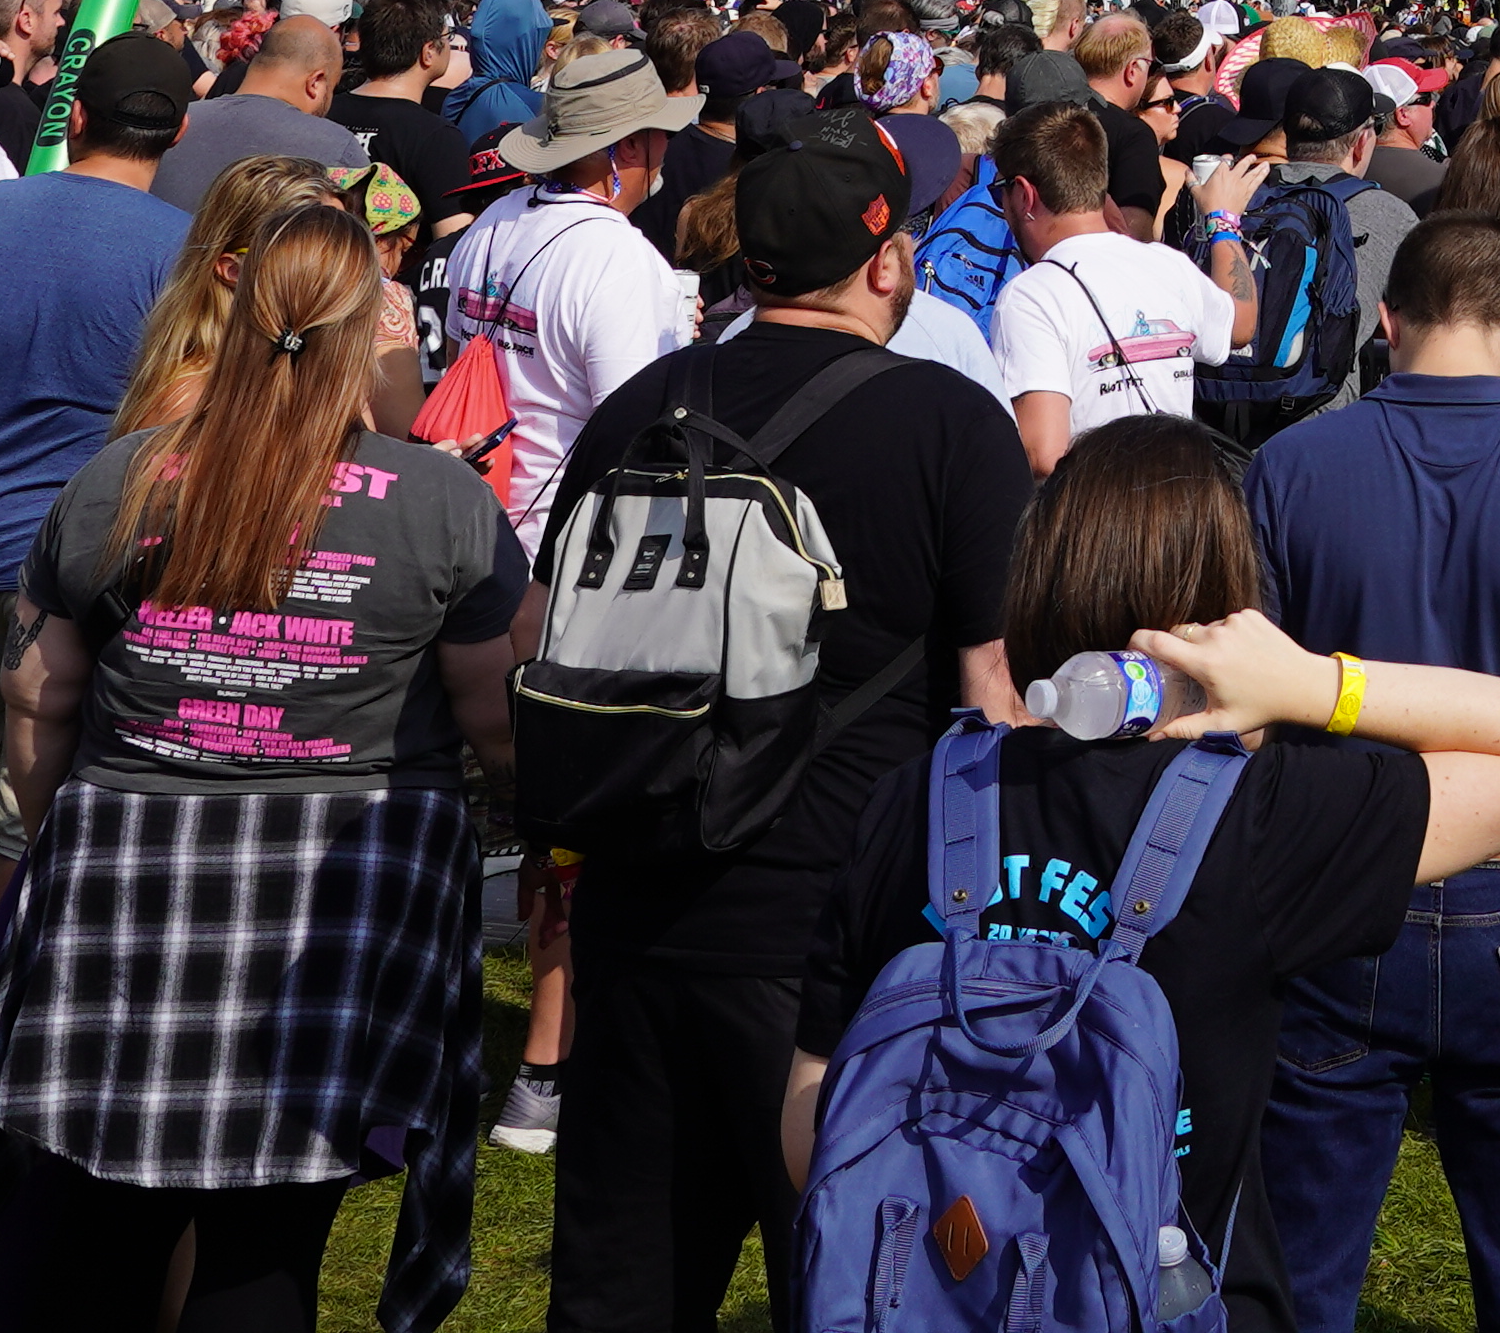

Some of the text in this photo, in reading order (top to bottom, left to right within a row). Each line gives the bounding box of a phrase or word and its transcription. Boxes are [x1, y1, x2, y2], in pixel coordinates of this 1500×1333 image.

[40, 36, 92, 138] CRAYON
[137, 601, 355, 646] WEEZER JACK WHITE
[177, 697, 286, 730] GREEN DAY
[1038, 857, 1116, 939] FES
[987, 923, 1012, 941] 20
